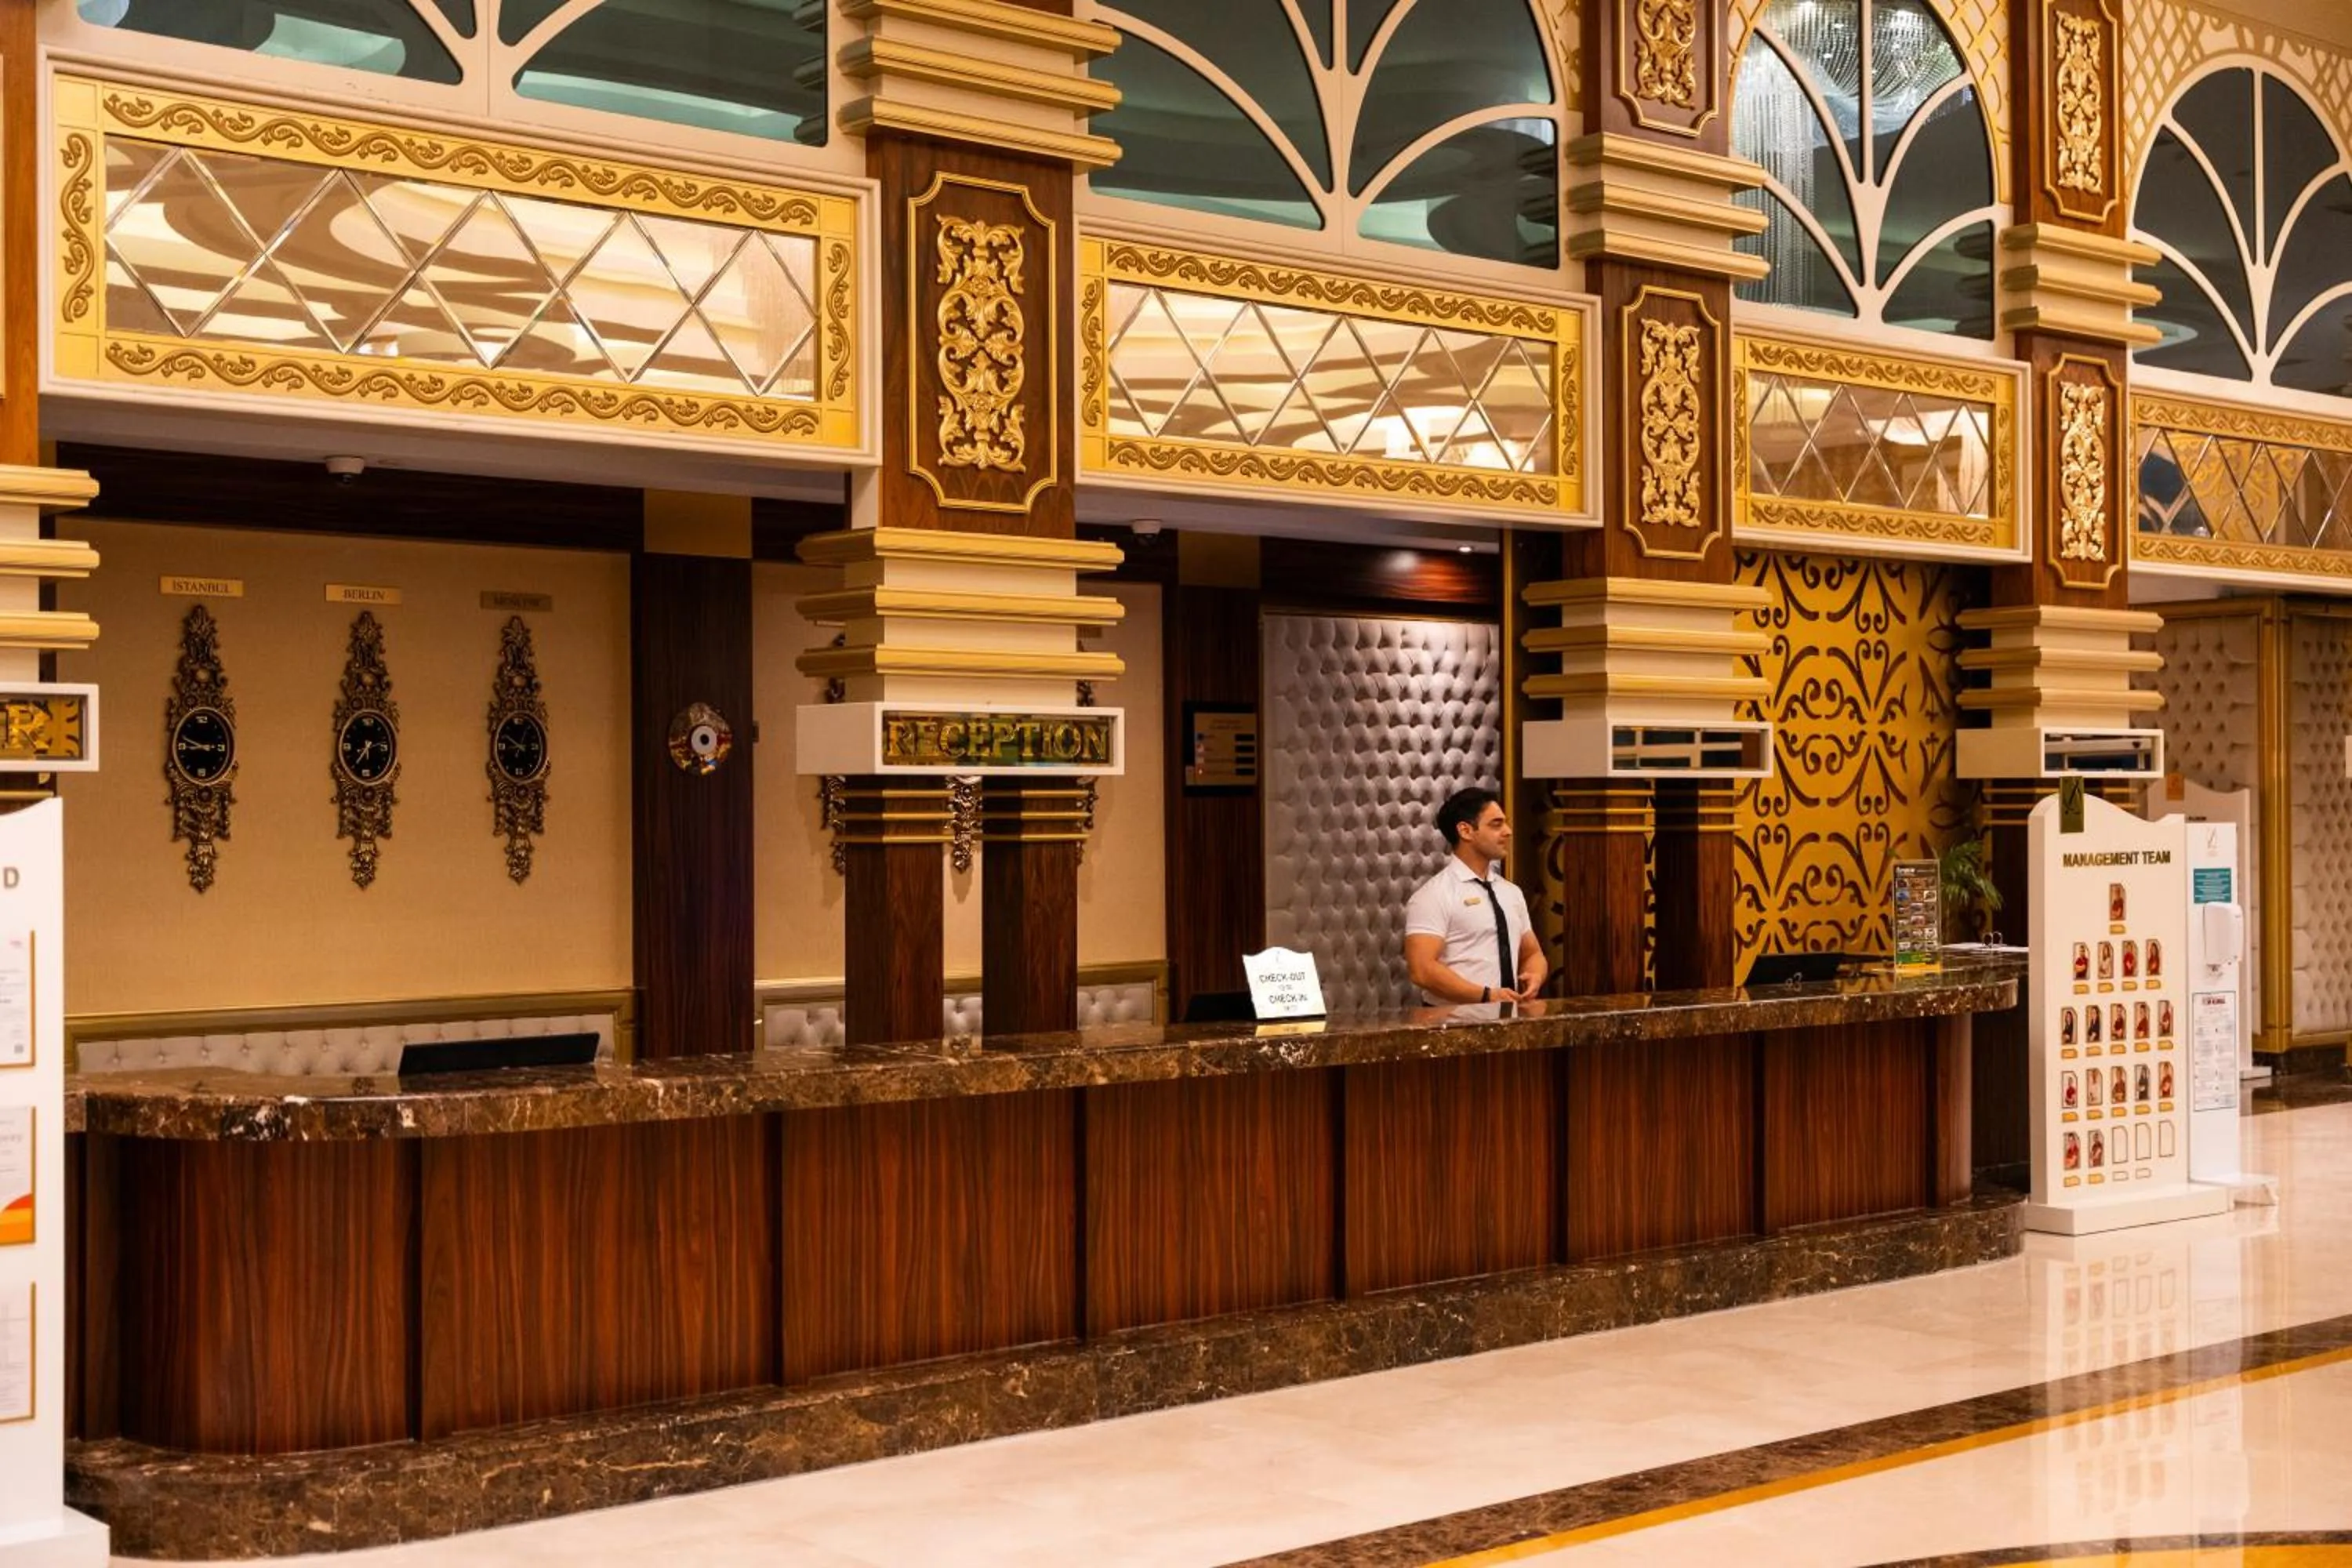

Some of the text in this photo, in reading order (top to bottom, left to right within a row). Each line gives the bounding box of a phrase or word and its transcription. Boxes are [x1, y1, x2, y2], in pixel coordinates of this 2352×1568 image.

[343, 588, 386, 601] BERLIN
[887, 720, 1109, 759] RECEPTION
[2063, 850, 2171, 868] MANAGEMENT TEAM
